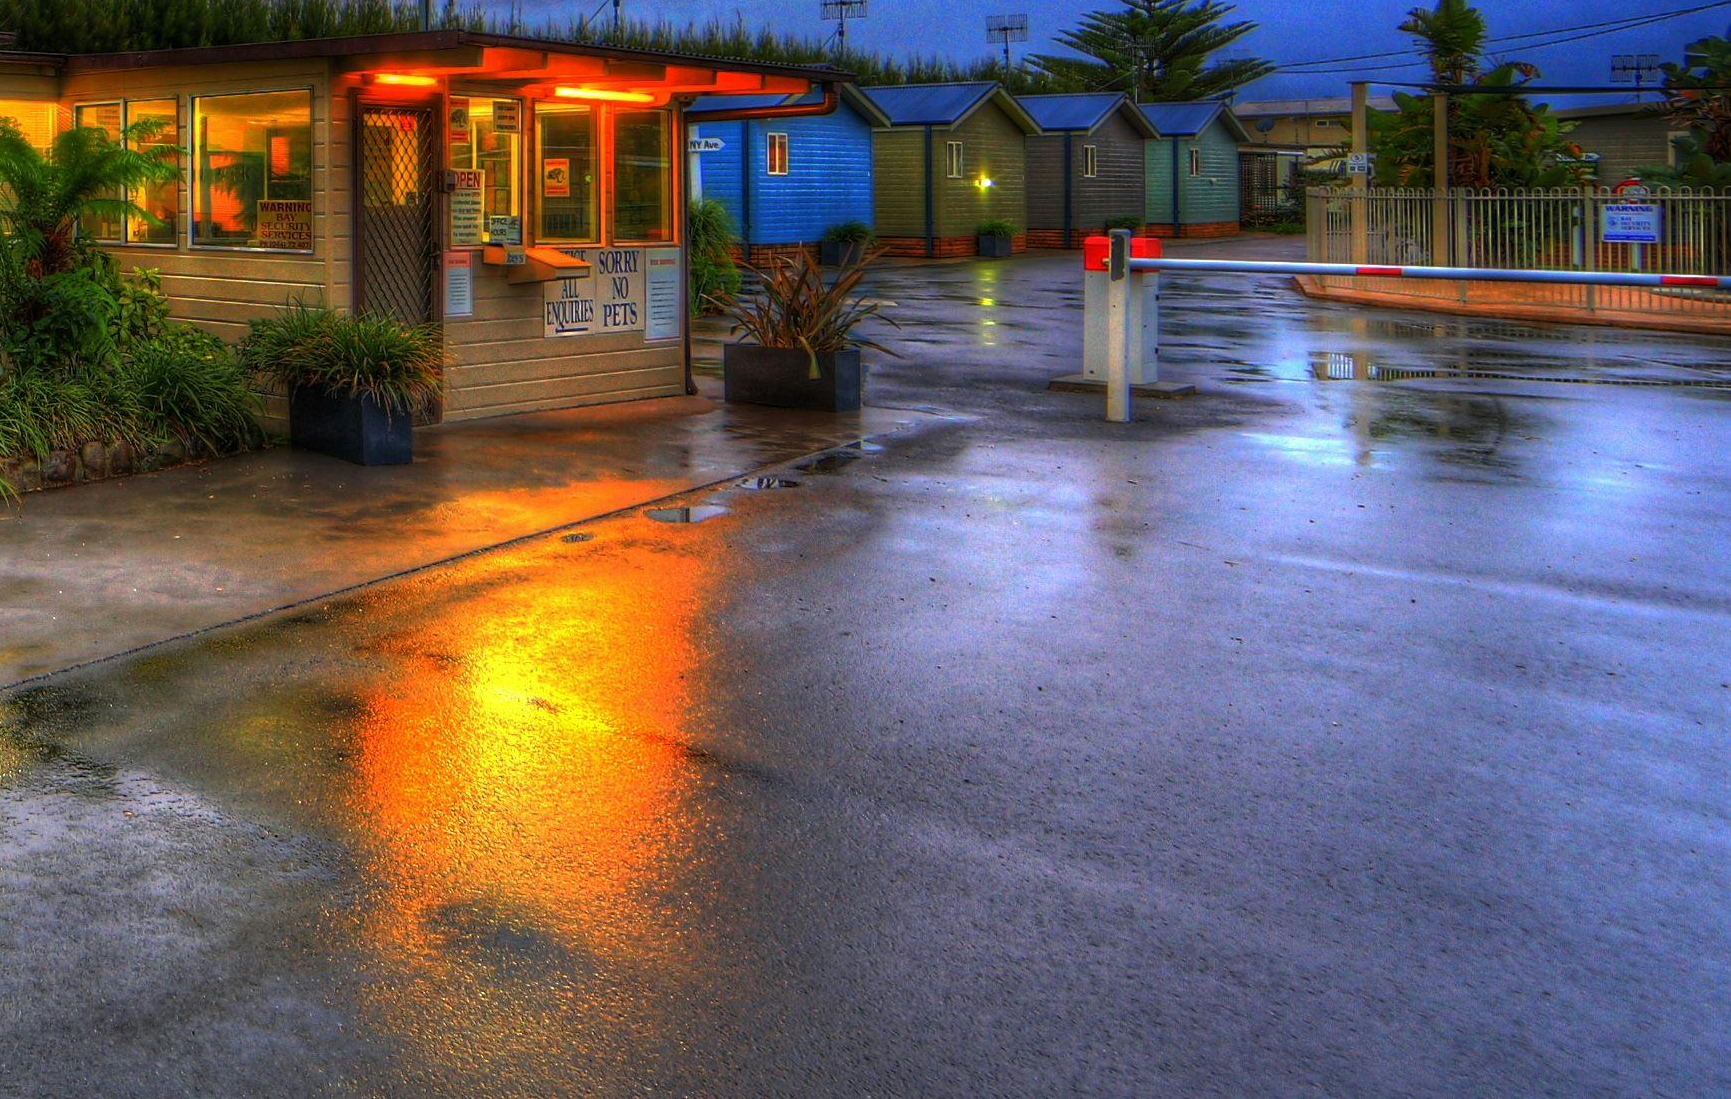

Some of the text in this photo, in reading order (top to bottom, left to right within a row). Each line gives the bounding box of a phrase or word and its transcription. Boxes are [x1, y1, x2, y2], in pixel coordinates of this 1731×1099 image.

[704, 140, 719, 149] Ave
[276, 213, 297, 221] BAY
[261, 231, 312, 240] SERVICES
[598, 250, 640, 275] SORRY
[561, 279, 580, 299] ALL
[612, 276, 629, 300] NO
[545, 299, 593, 328] ENQUIRIES
[602, 302, 638, 327] PETS
